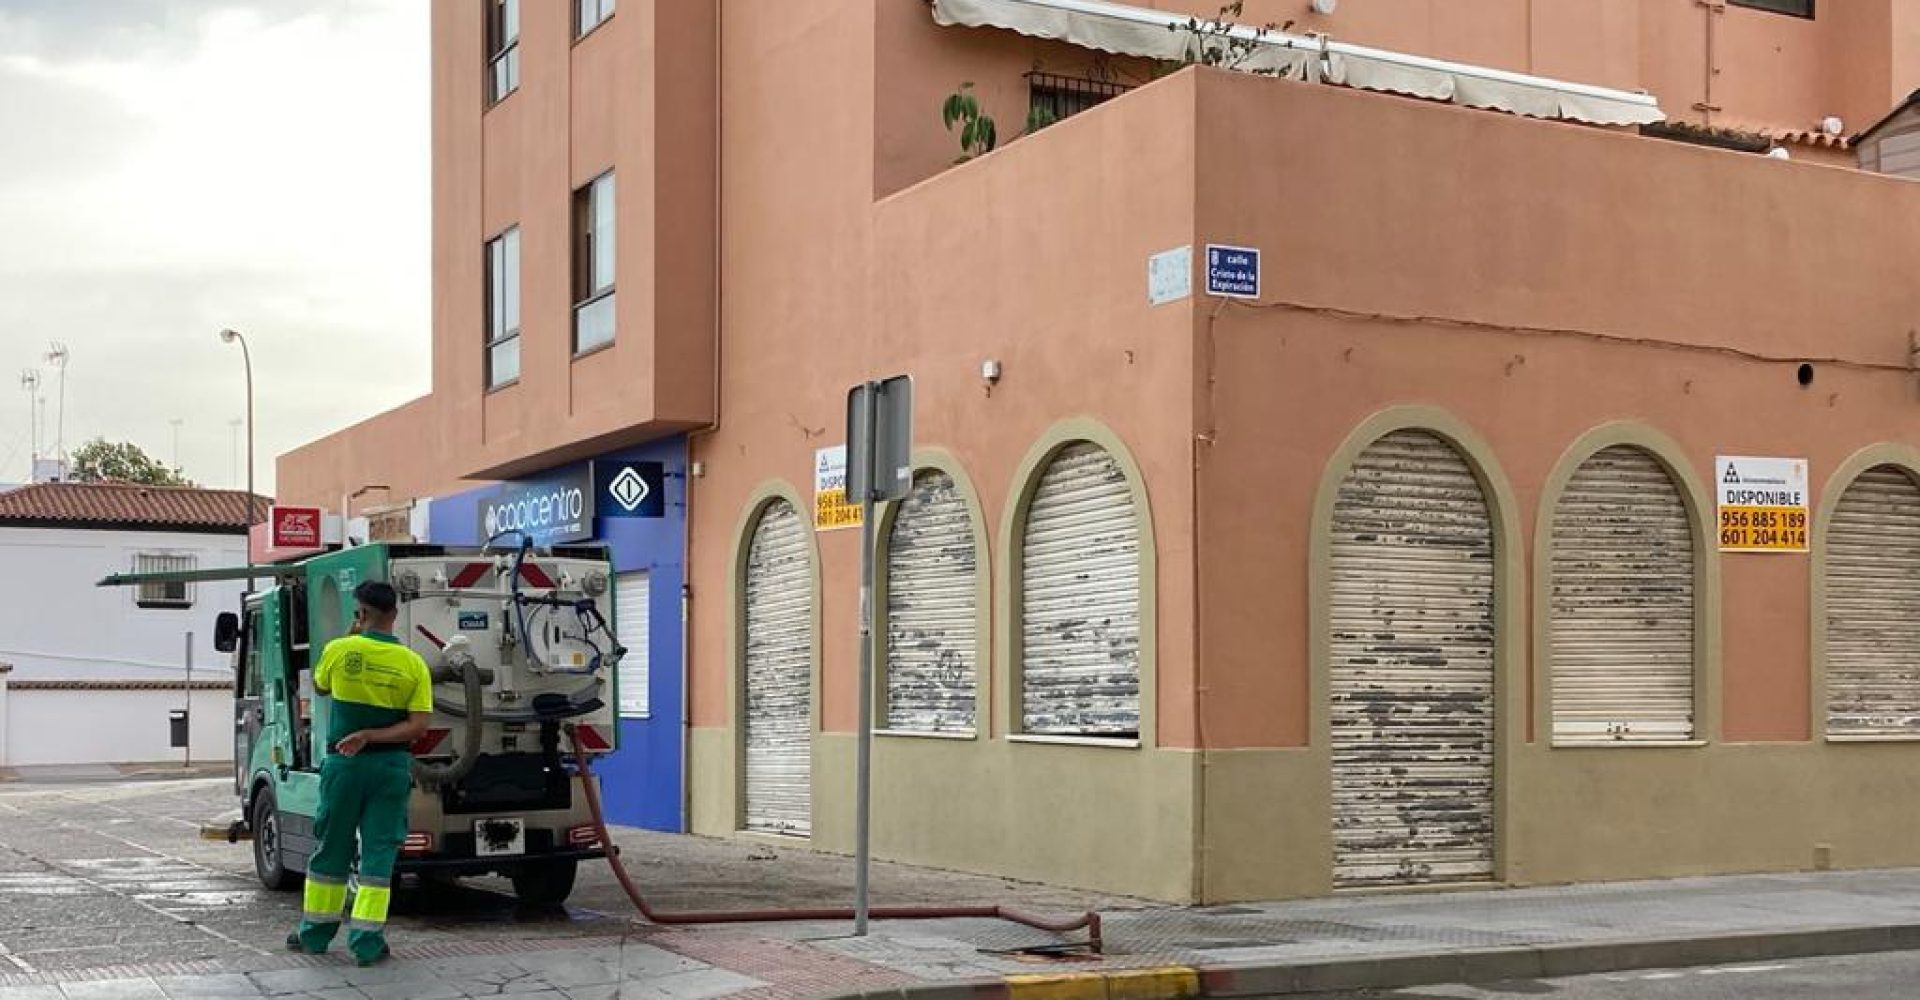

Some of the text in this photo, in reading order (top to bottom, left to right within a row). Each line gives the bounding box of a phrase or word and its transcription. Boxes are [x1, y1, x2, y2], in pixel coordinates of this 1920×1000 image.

[1227, 254, 1248, 265] calle
[1211, 268, 1255, 281] Cristo de la
[1726, 489, 1801, 505] DISPONIBLE
[498, 485, 582, 541] copicentro
[1722, 511, 1806, 528] 956 885 189
[1721, 529, 1806, 545] 601 204 414
